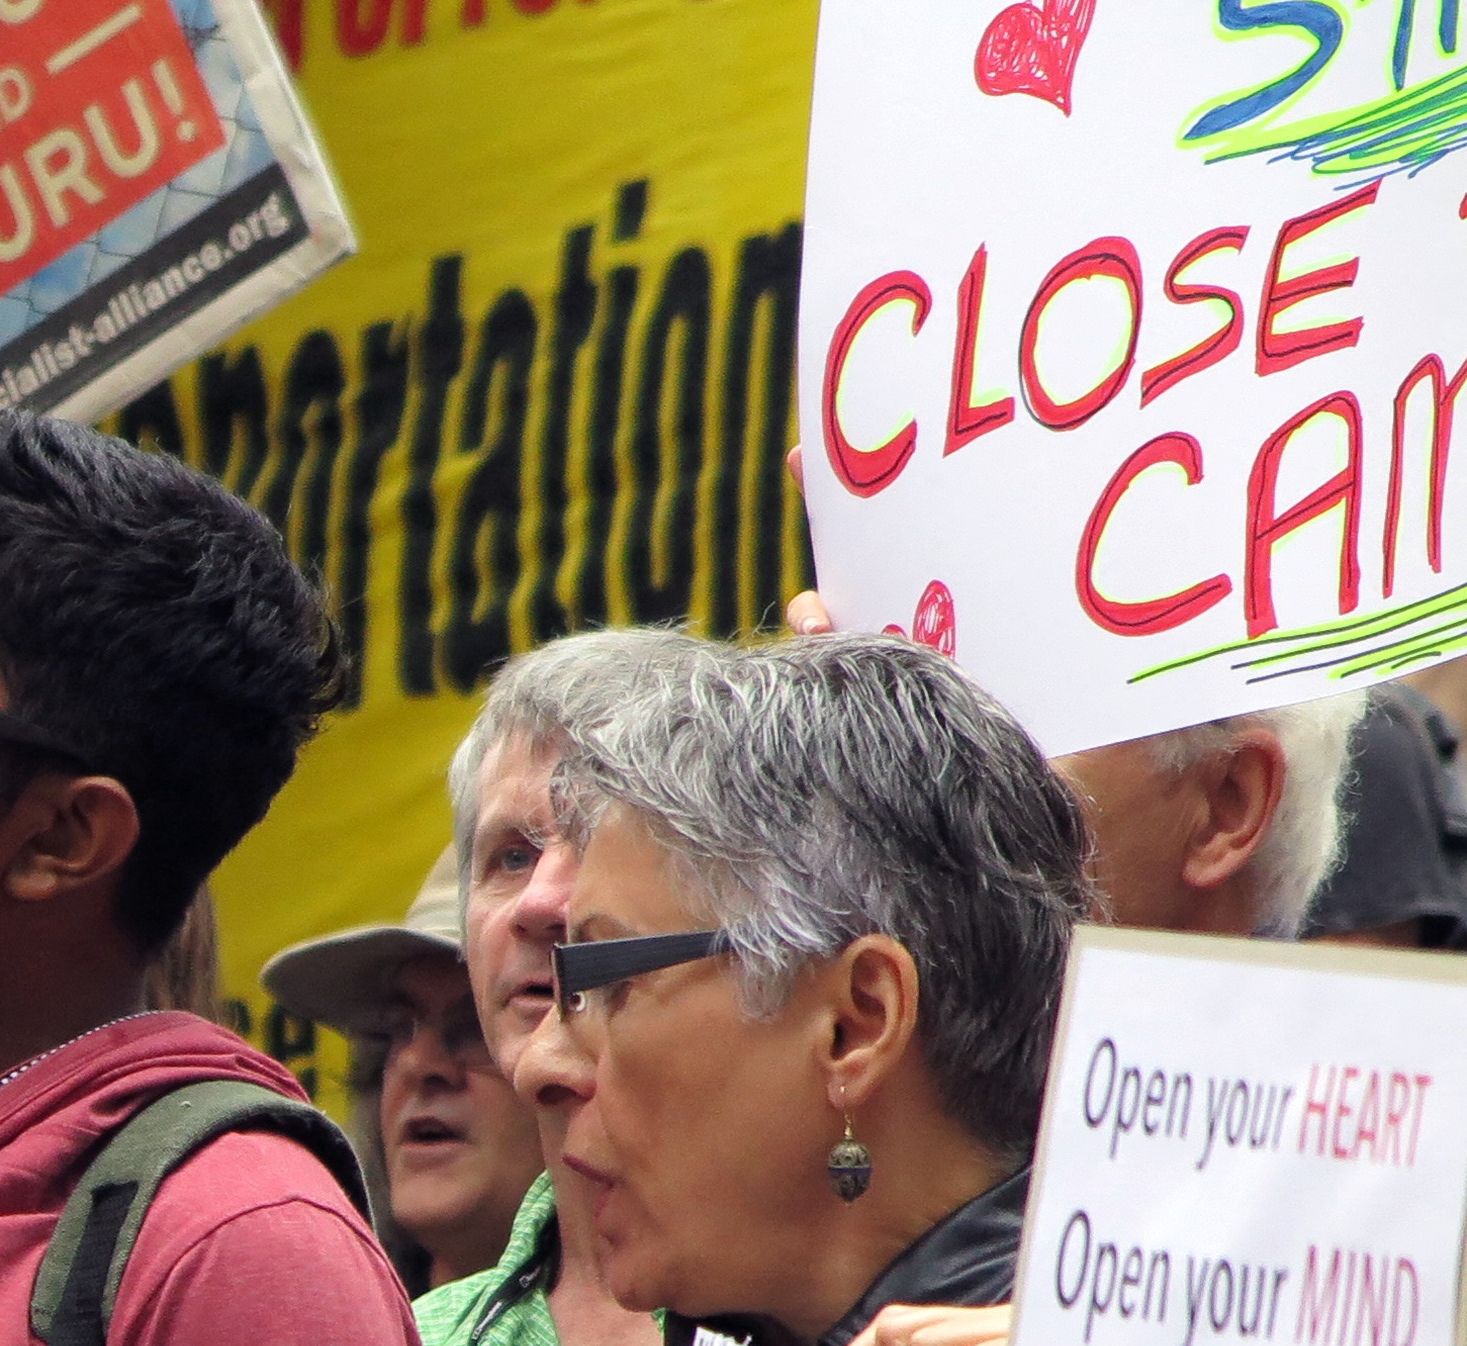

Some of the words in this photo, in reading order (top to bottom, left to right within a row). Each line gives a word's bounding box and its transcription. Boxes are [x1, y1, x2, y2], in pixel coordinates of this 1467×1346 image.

[822, 178, 1383, 498] CLOSE
[1082, 1037, 1193, 1159] Open
[1195, 1075, 1294, 1170] your
[1296, 1063, 1433, 1168] HEART
[1055, 1208, 1170, 1343] Open
